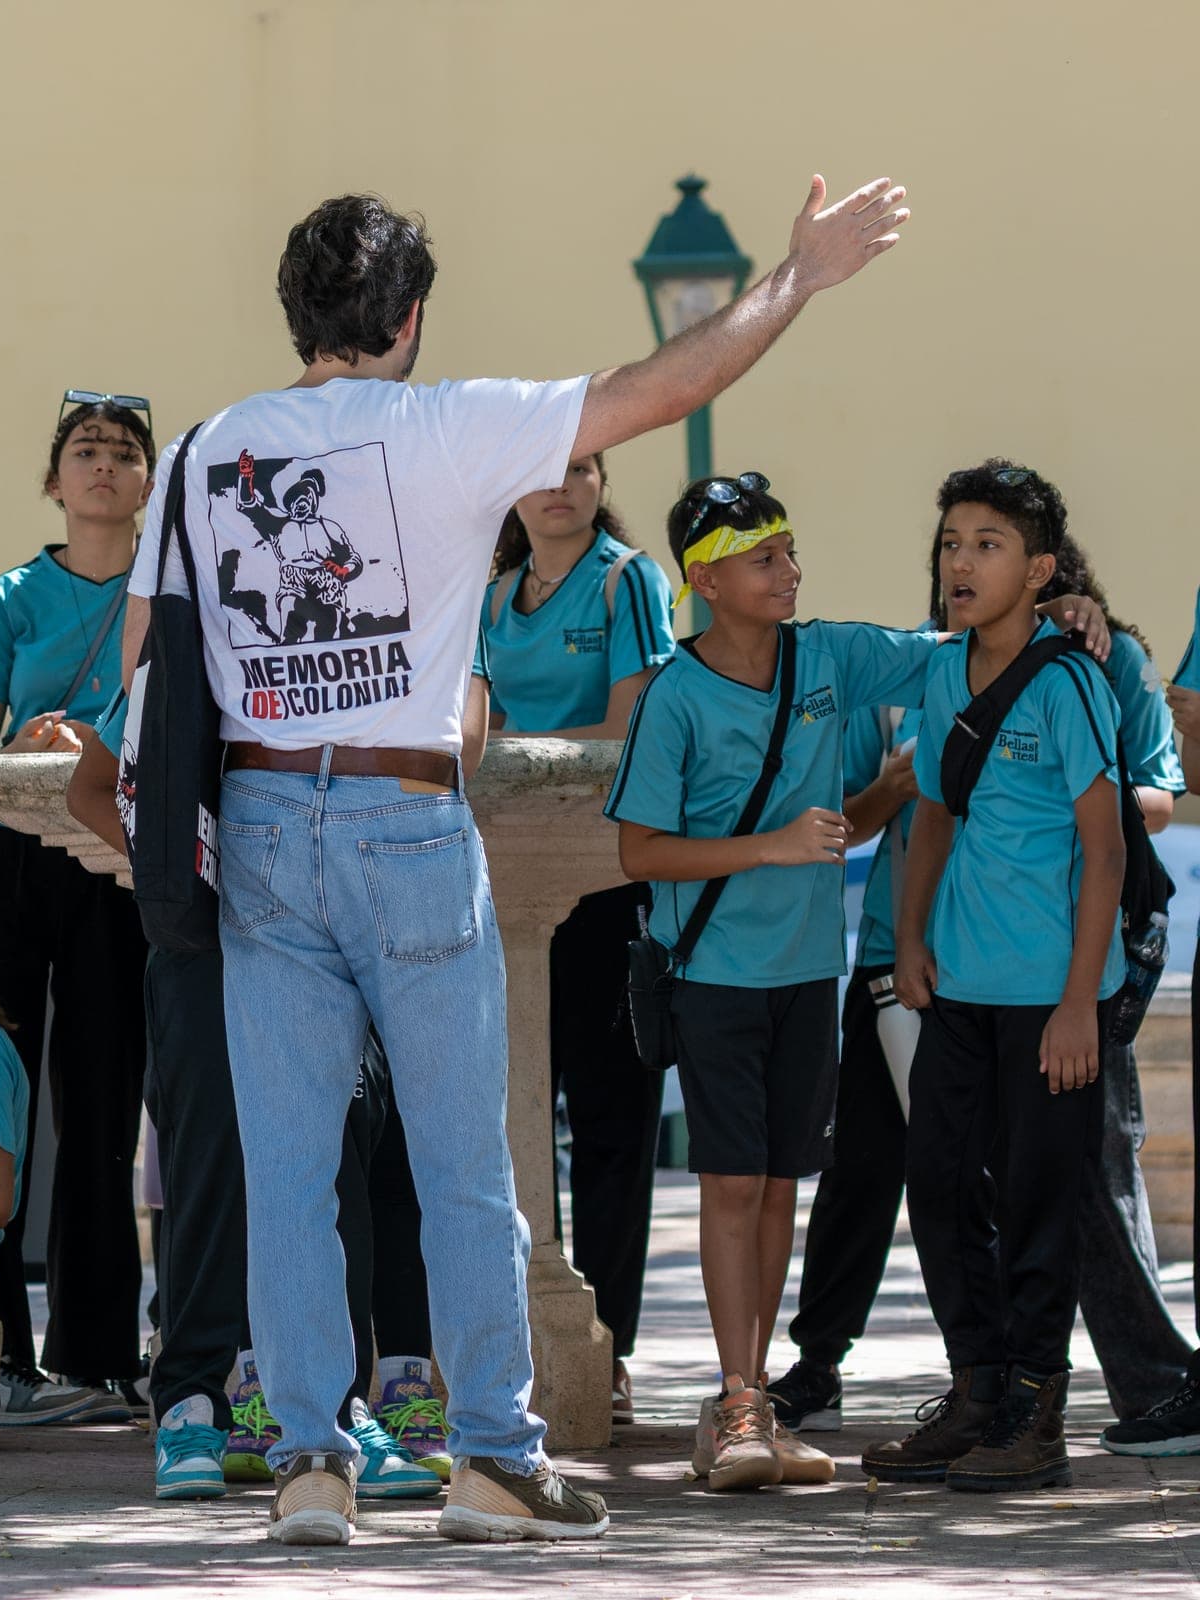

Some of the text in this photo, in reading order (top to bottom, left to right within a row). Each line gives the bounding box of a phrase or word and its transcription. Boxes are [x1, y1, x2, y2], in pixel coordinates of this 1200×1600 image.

[239, 641, 413, 689] MEMORIA
[241, 674, 412, 720] (DE)COLONIAL
[998, 733, 1035, 751] Bellas
[1000, 745, 1035, 761] Artes
